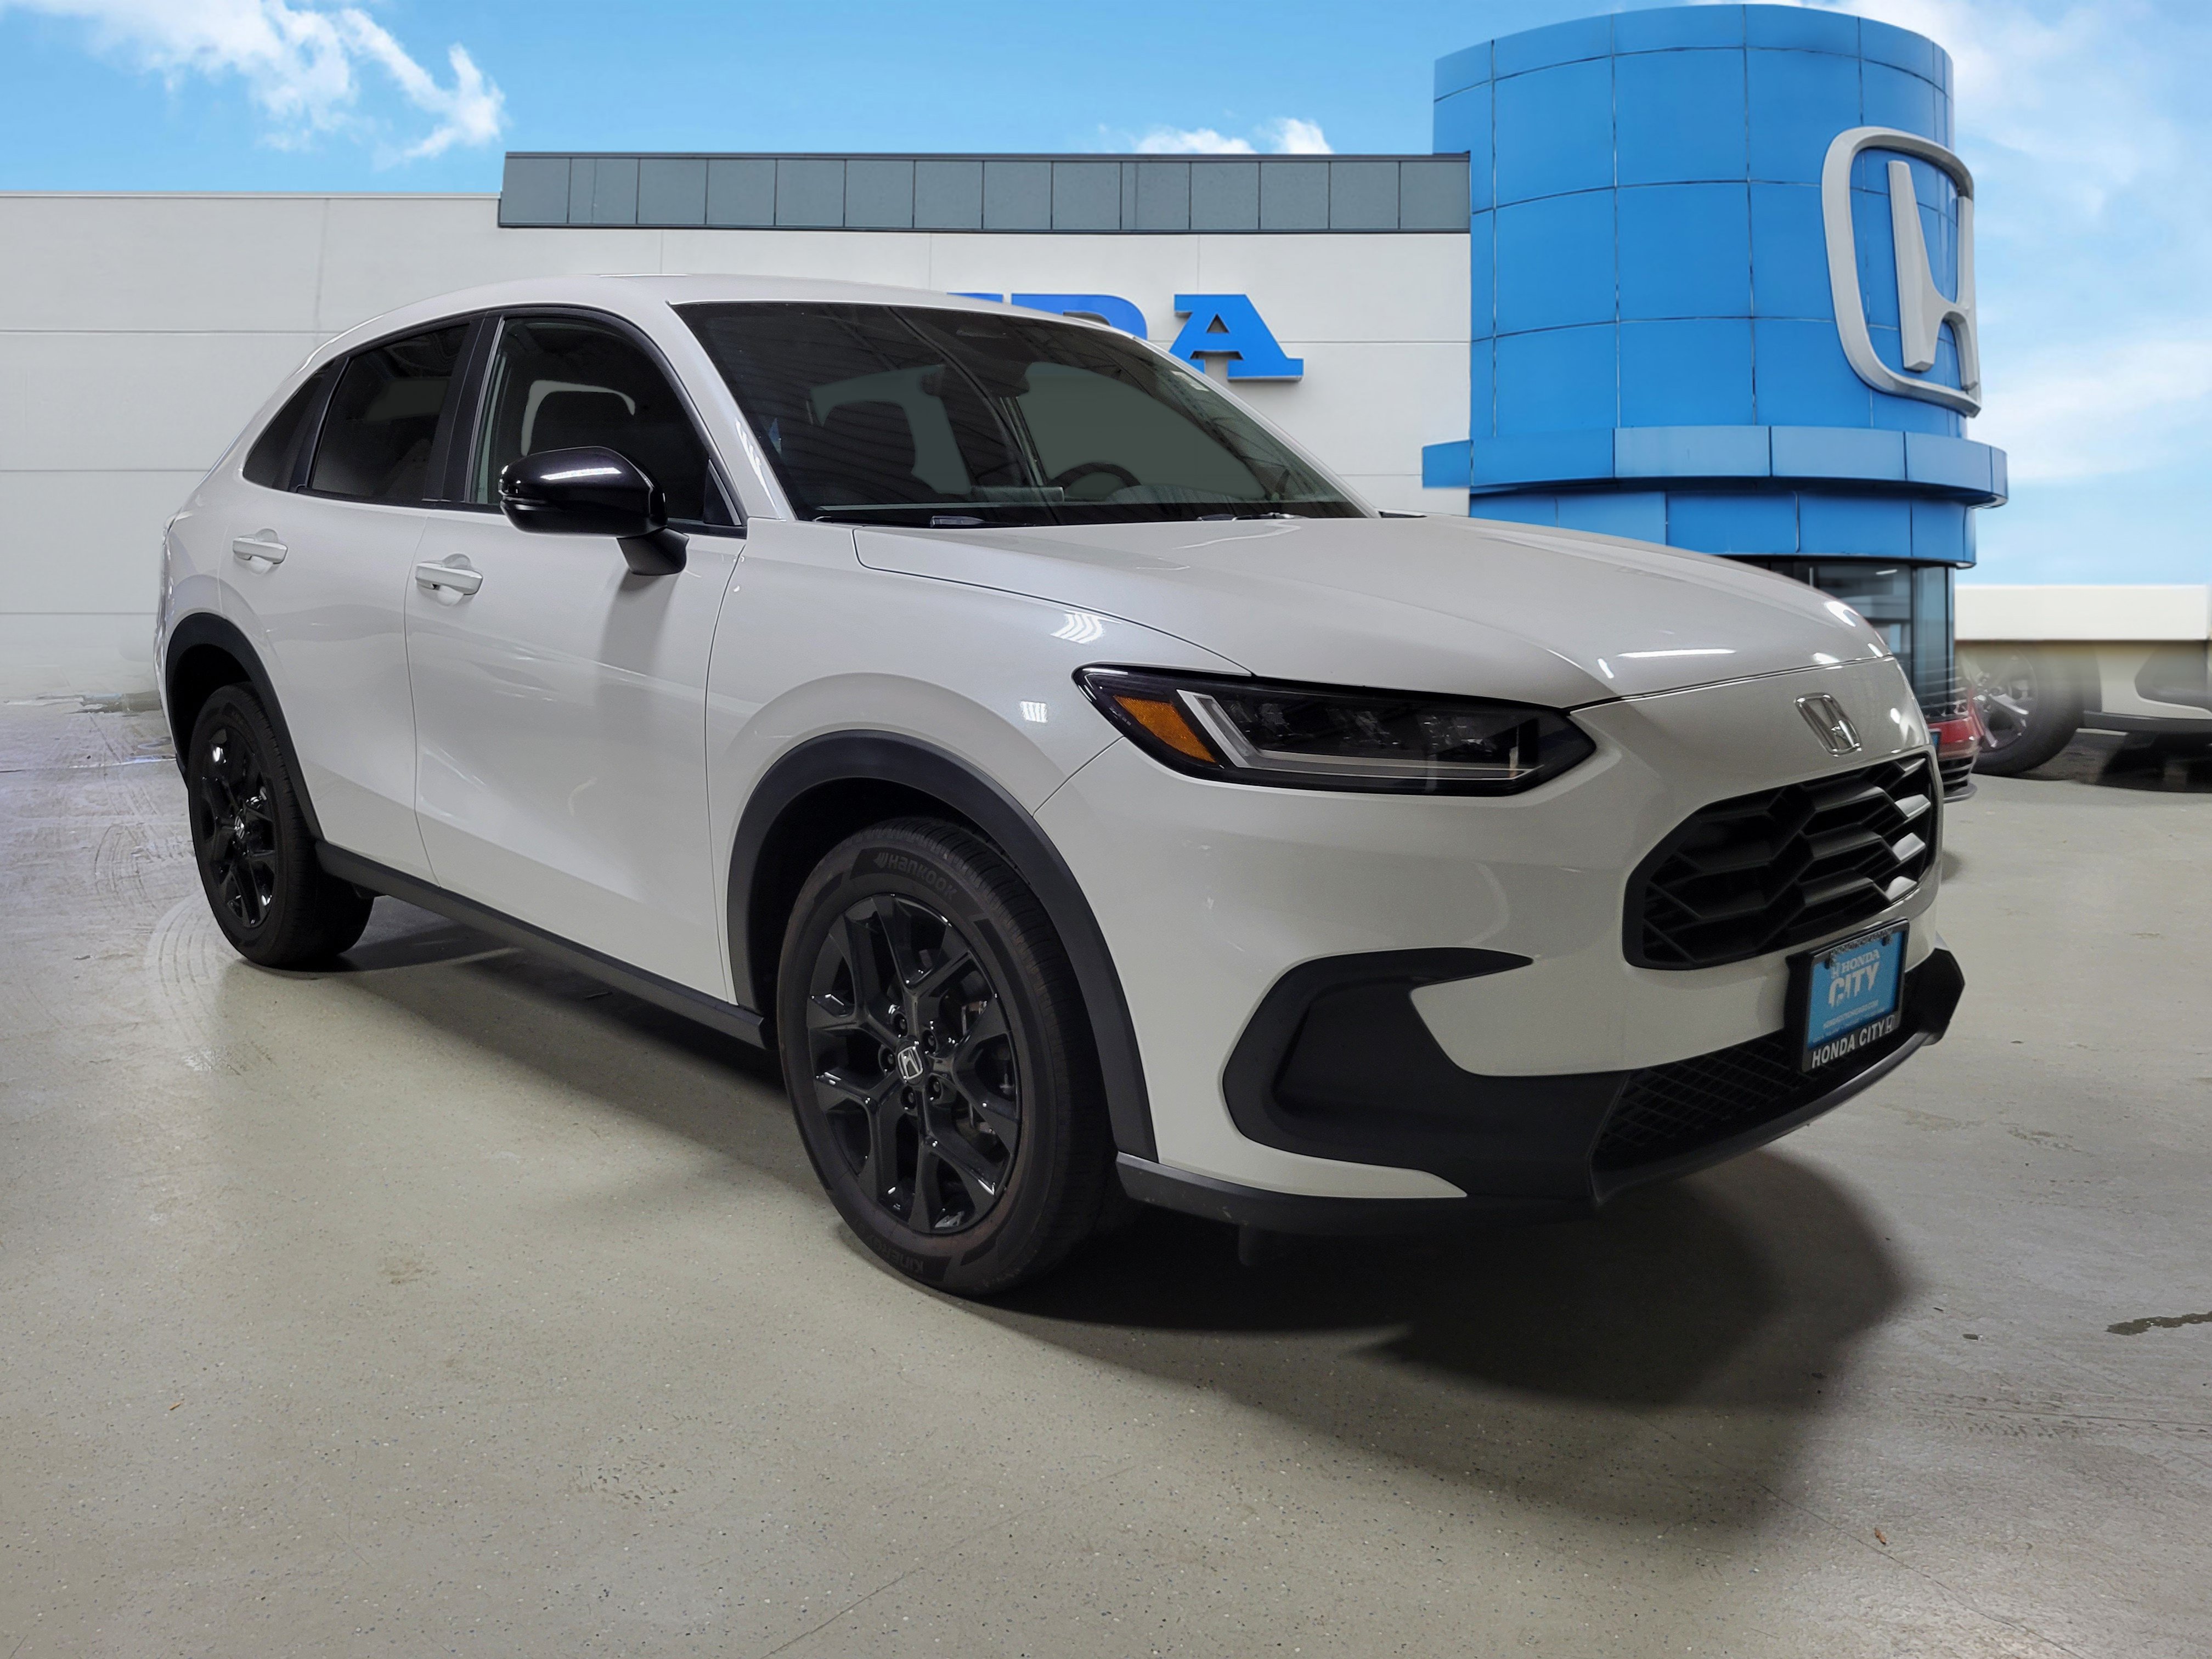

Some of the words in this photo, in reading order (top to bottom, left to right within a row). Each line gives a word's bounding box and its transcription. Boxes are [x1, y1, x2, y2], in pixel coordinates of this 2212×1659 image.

[1828, 961, 1880, 1008] CITY
[1842, 949, 1880, 973] HONDA
[1812, 1034, 1855, 1069] HONDA
[1859, 1018, 1885, 1046] CITY
